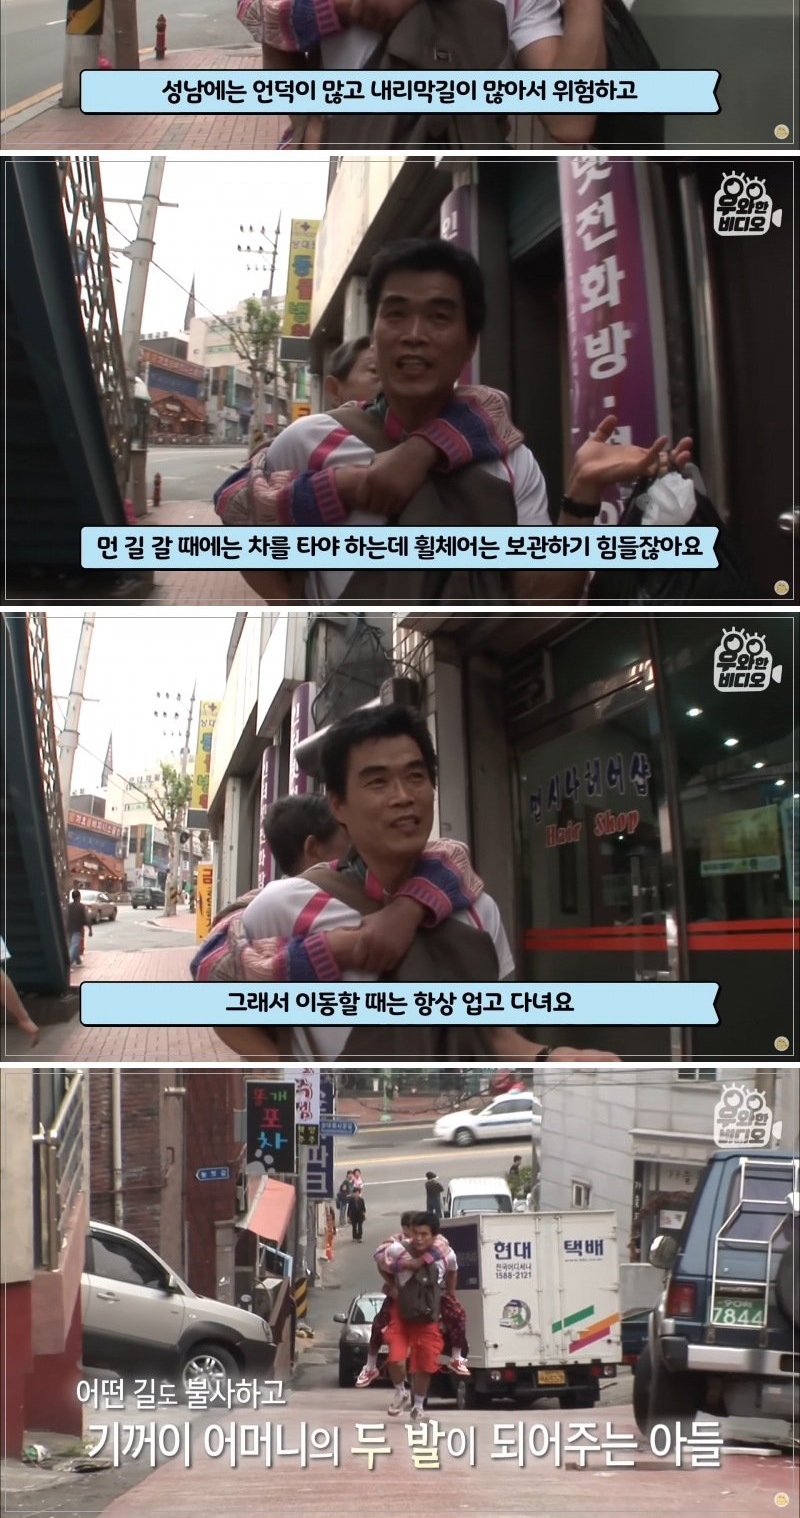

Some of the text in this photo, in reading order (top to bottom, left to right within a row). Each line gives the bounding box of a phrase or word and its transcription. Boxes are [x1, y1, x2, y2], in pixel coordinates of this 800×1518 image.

[546, 810, 640, 847] Hair Shop
[494, 1241, 531, 1260] 현대
[564, 1239, 604, 1256] 택배
[713, 1308, 763, 1325] 7844
